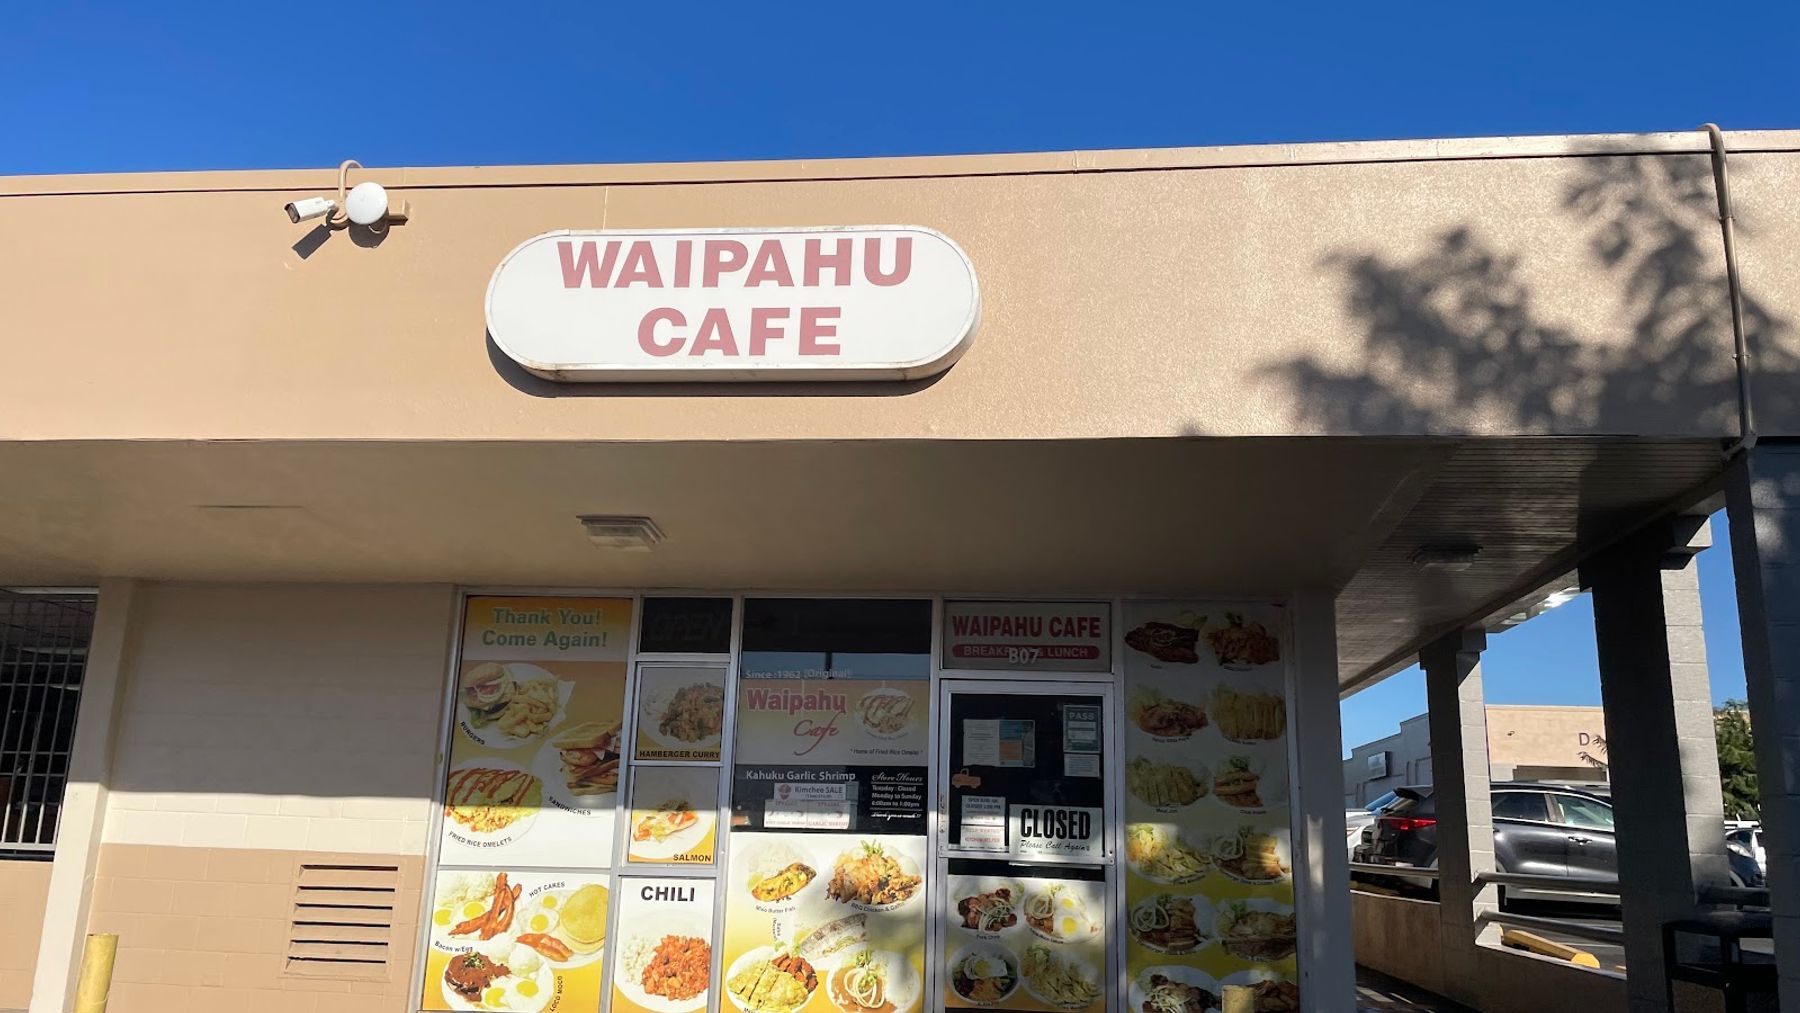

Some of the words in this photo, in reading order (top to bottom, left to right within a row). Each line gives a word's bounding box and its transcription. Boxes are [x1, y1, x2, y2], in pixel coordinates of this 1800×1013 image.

[557, 237, 913, 289] WAIPAHU
[637, 306, 841, 357] CAFE
[493, 608, 551, 625] Thank
[559, 609, 601, 626] You!
[952, 615, 1043, 637] WAIPAHU
[1048, 616, 1101, 638] CAFE
[482, 631, 537, 648] Come
[543, 631, 608, 650] Again!
[1048, 647, 1088, 658] LUNCH
[745, 670, 772, 679] Since
[746, 687, 847, 716] Waipahu
[1069, 711, 1095, 721] PASS
[460, 721, 485, 745] BURGERS
[793, 710, 847, 756] Cafe
[639, 750, 691, 759] HAMBERGER
[692, 750, 720, 760] CURRY
[746, 770, 785, 781] Kahuku
[786, 771, 816, 781] Garlic
[818, 771, 856, 783] Shrimp
[794, 786, 824, 794] Kimchee
[825, 786, 843, 794] SALE
[549, 796, 591, 816] SANDWICHES
[1020, 808, 1091, 840] CLOSED
[448, 831, 466, 843] FRIED
[466, 839, 481, 848] RICE
[482, 836, 512, 848] OMELETS
[1020, 839, 1043, 848] Please
[1045, 840, 1062, 849] Call
[672, 853, 712, 863] SALMON
[529, 886, 542, 898] HOT
[543, 881, 566, 890] CAKES
[640, 886, 696, 902] CHILI
[550, 996, 561, 1012] LOCO
